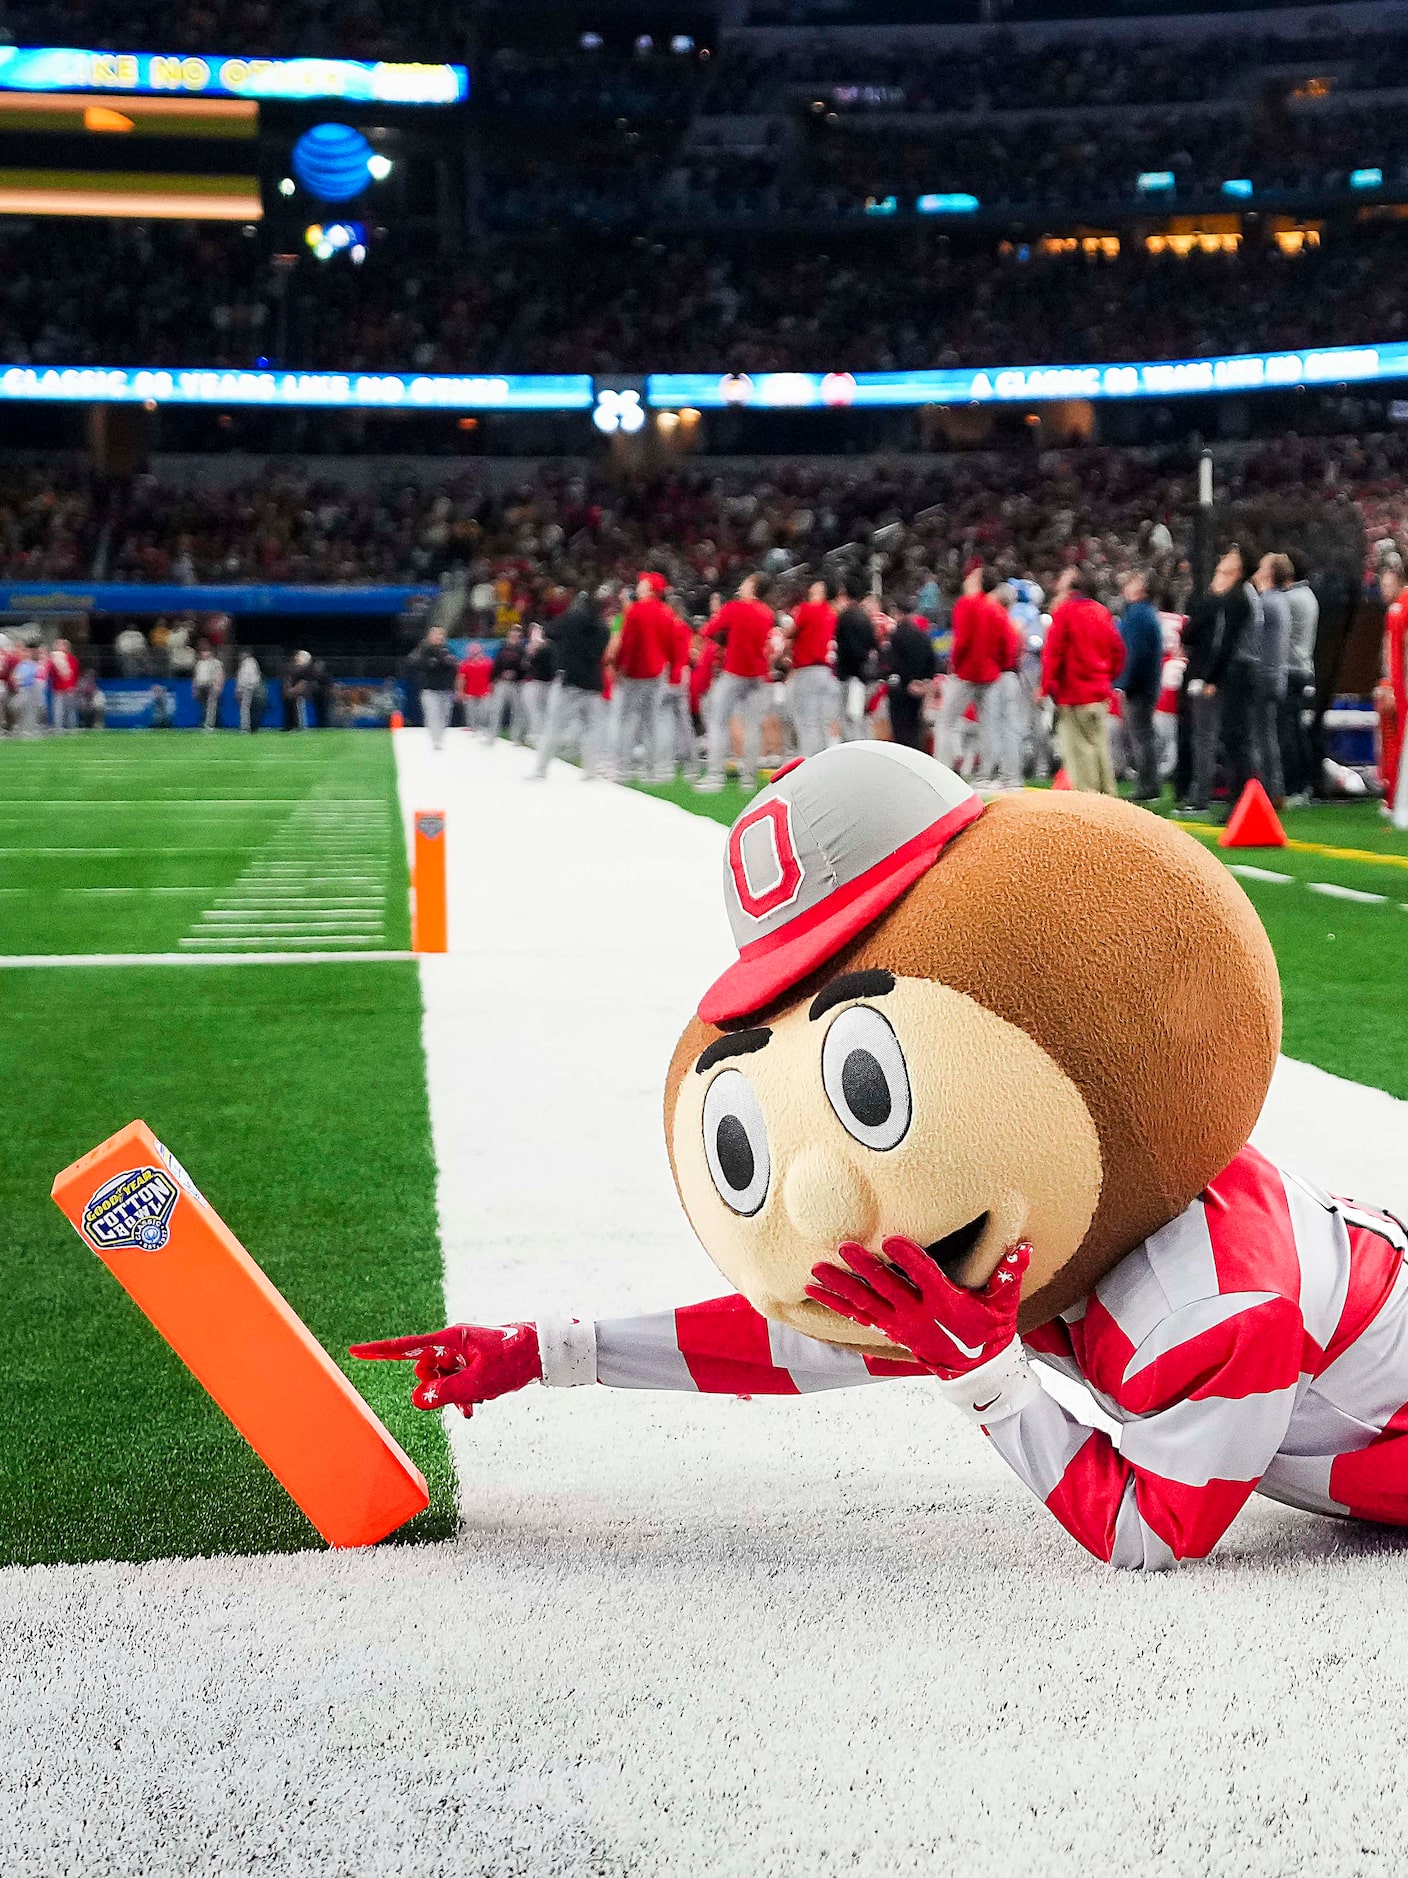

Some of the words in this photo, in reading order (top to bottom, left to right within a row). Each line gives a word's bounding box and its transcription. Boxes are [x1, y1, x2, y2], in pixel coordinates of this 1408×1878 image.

[150, 56, 210, 90] NO
[728, 794, 805, 923] O
[92, 1177, 170, 1240] COTTON
[113, 1200, 162, 1237] BOWL
